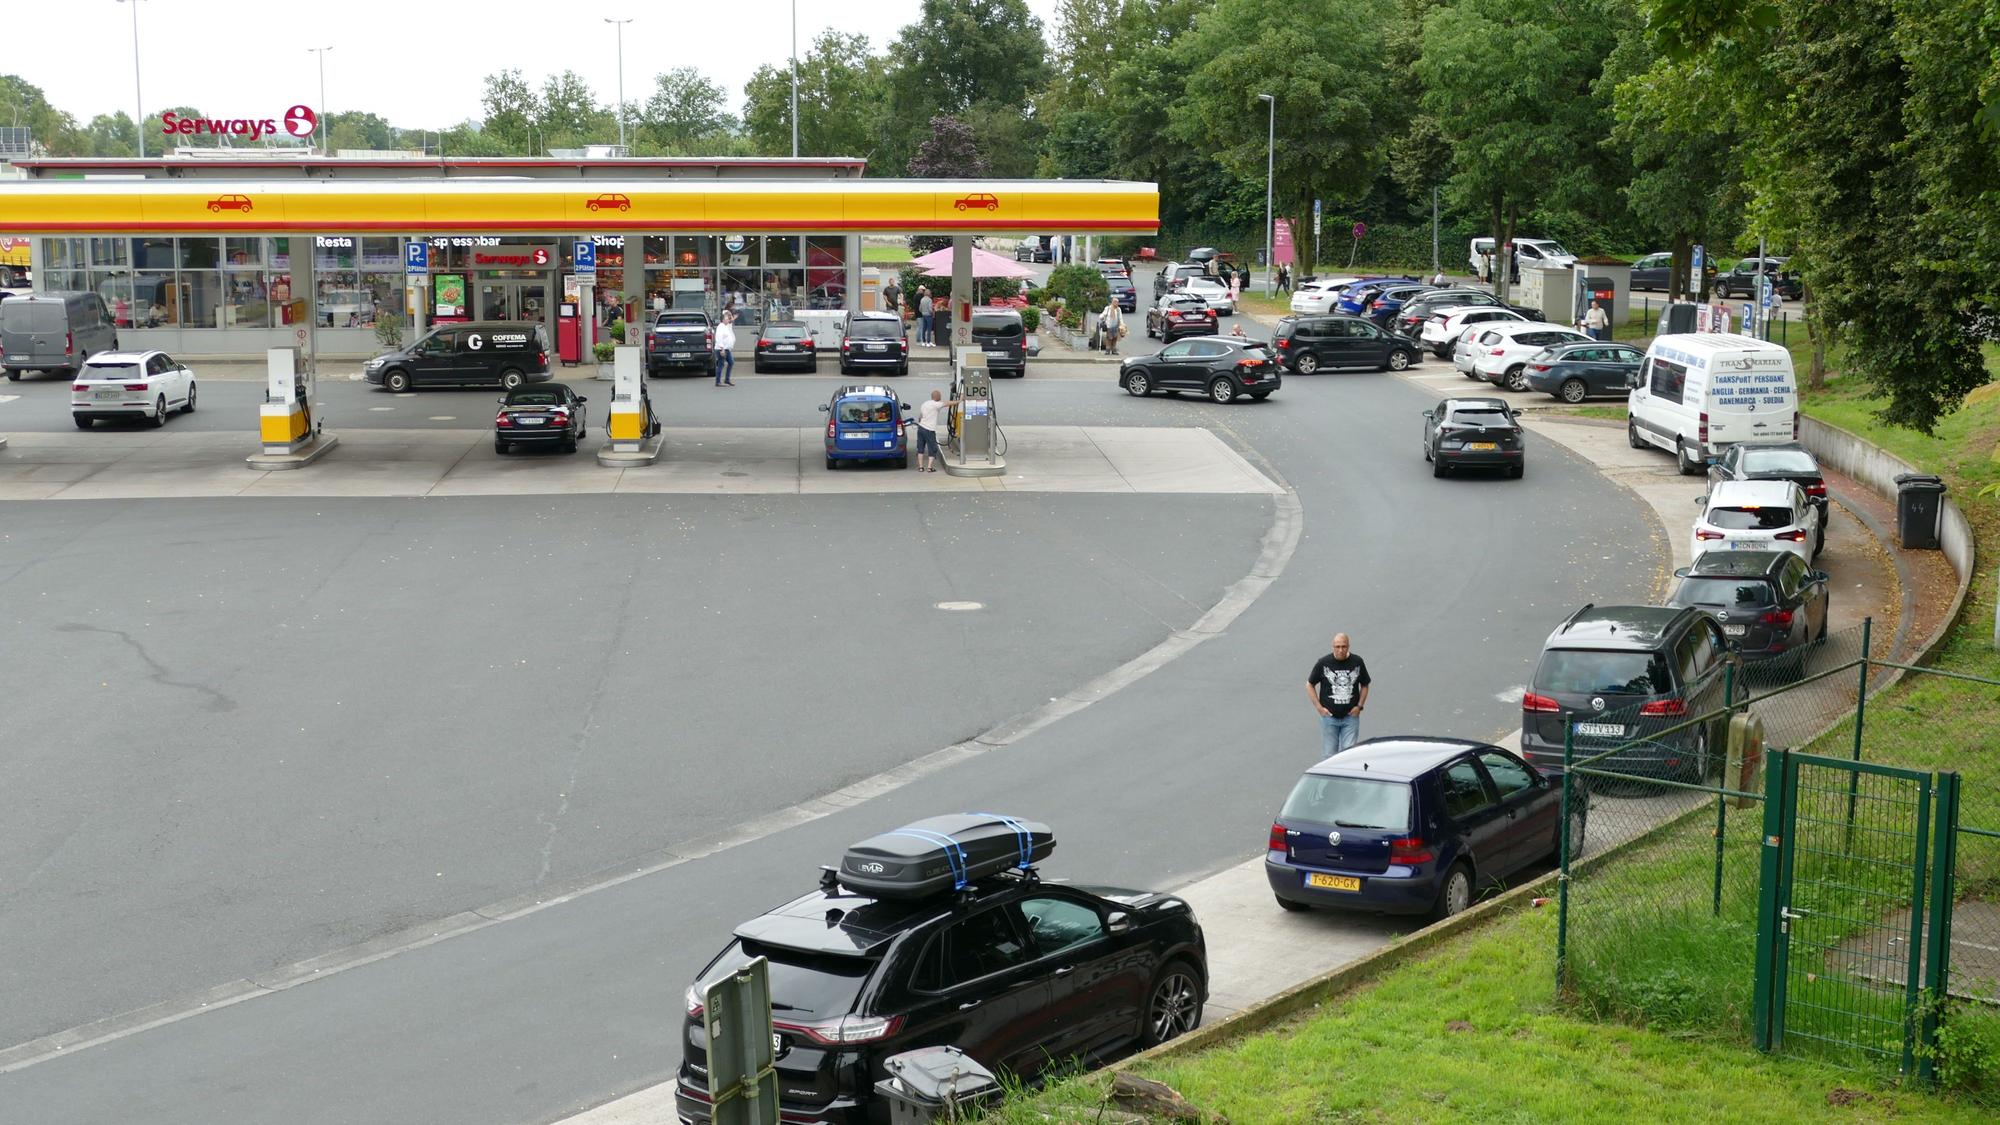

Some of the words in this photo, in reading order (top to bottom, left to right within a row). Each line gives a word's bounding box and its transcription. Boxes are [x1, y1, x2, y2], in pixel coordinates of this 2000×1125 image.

[162, 112, 276, 141] Serways
[409, 244, 421, 261] P
[577, 244, 589, 261] P
[1715, 375, 1751, 384] TRANSPORT
[966, 386, 988, 397] LPG
[1712, 387, 1734, 396] ANGLIA
[1738, 386, 1769, 395] GERMANIA
[1719, 397, 1756, 405] DANEMARCA
[1763, 396, 1784, 405] SUEDIA
[1313, 873, 1356, 889] T-620-GK
